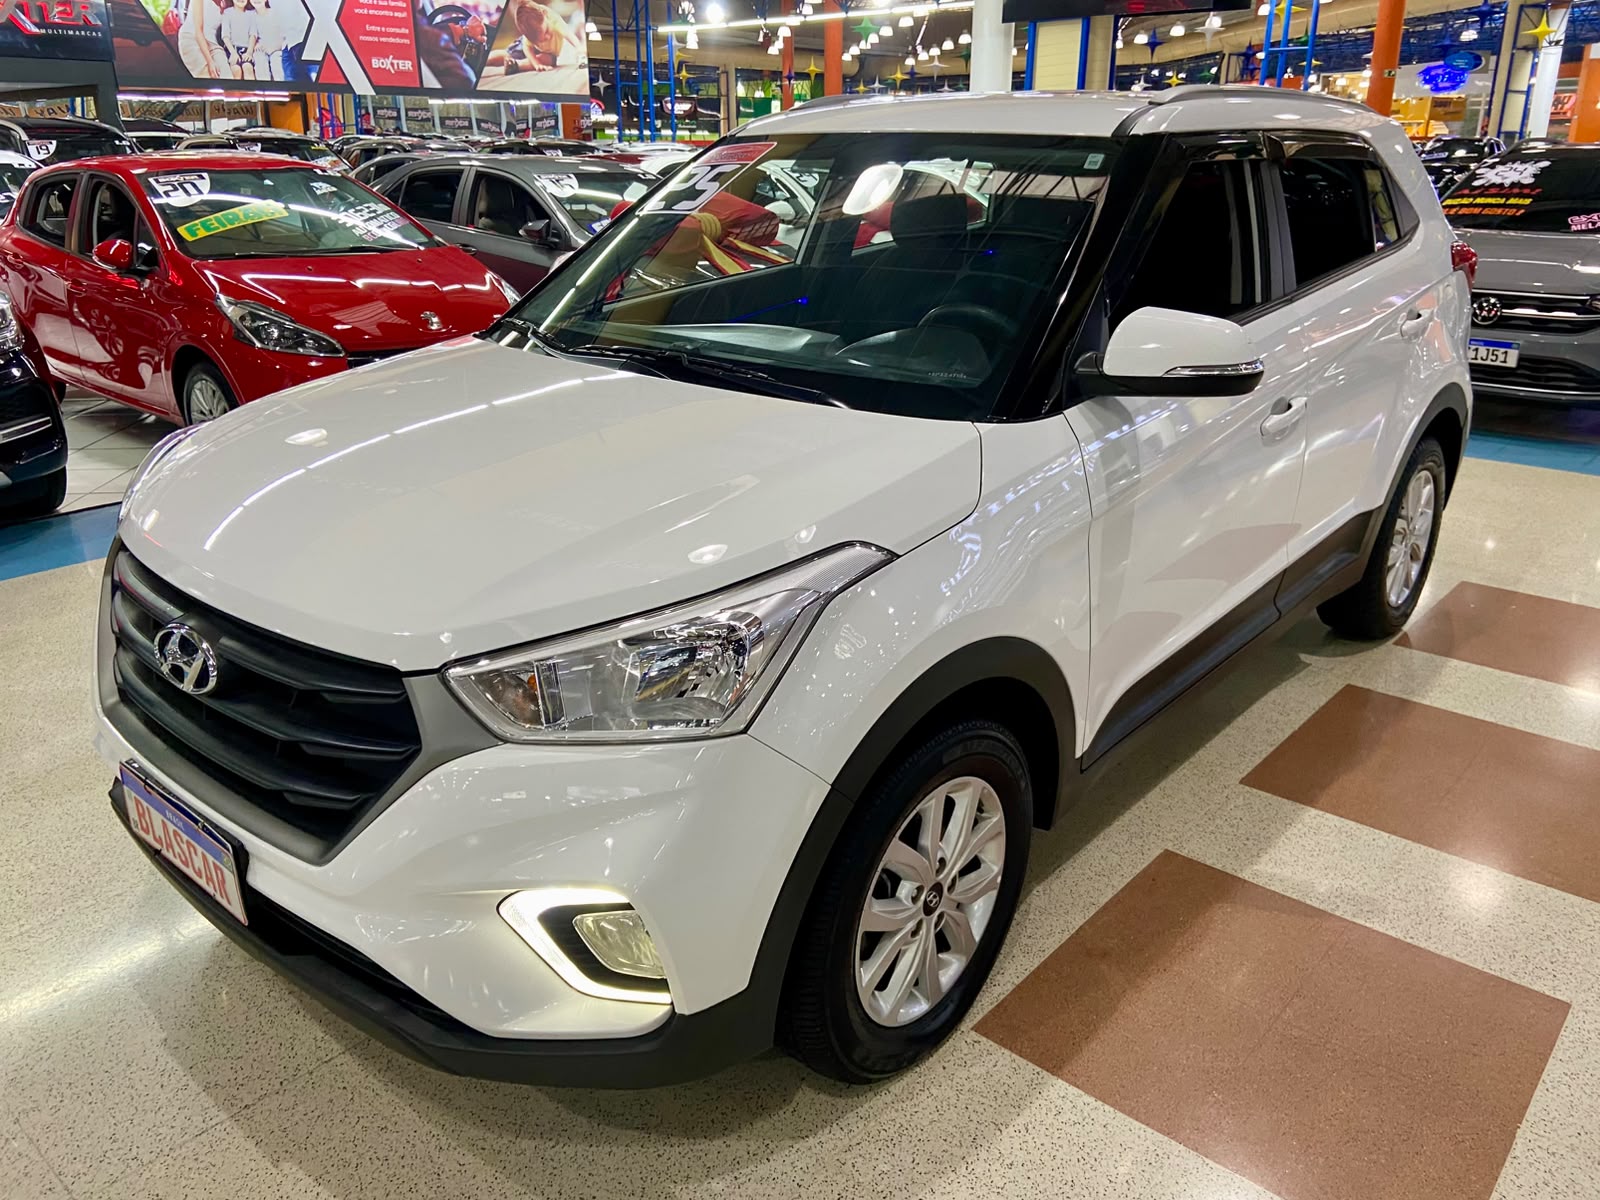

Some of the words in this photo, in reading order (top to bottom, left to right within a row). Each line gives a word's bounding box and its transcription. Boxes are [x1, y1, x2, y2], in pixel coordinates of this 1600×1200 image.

[369, 9, 393, 17] encontra
[40, 28, 102, 37] MULTIMARCAS
[371, 54, 413, 74] BOXTER
[35, 144, 51, 155] 19
[161, 181, 204, 198] 20
[1468, 346, 1509, 364] 1J51
[133, 795, 232, 907] BLASCAR
